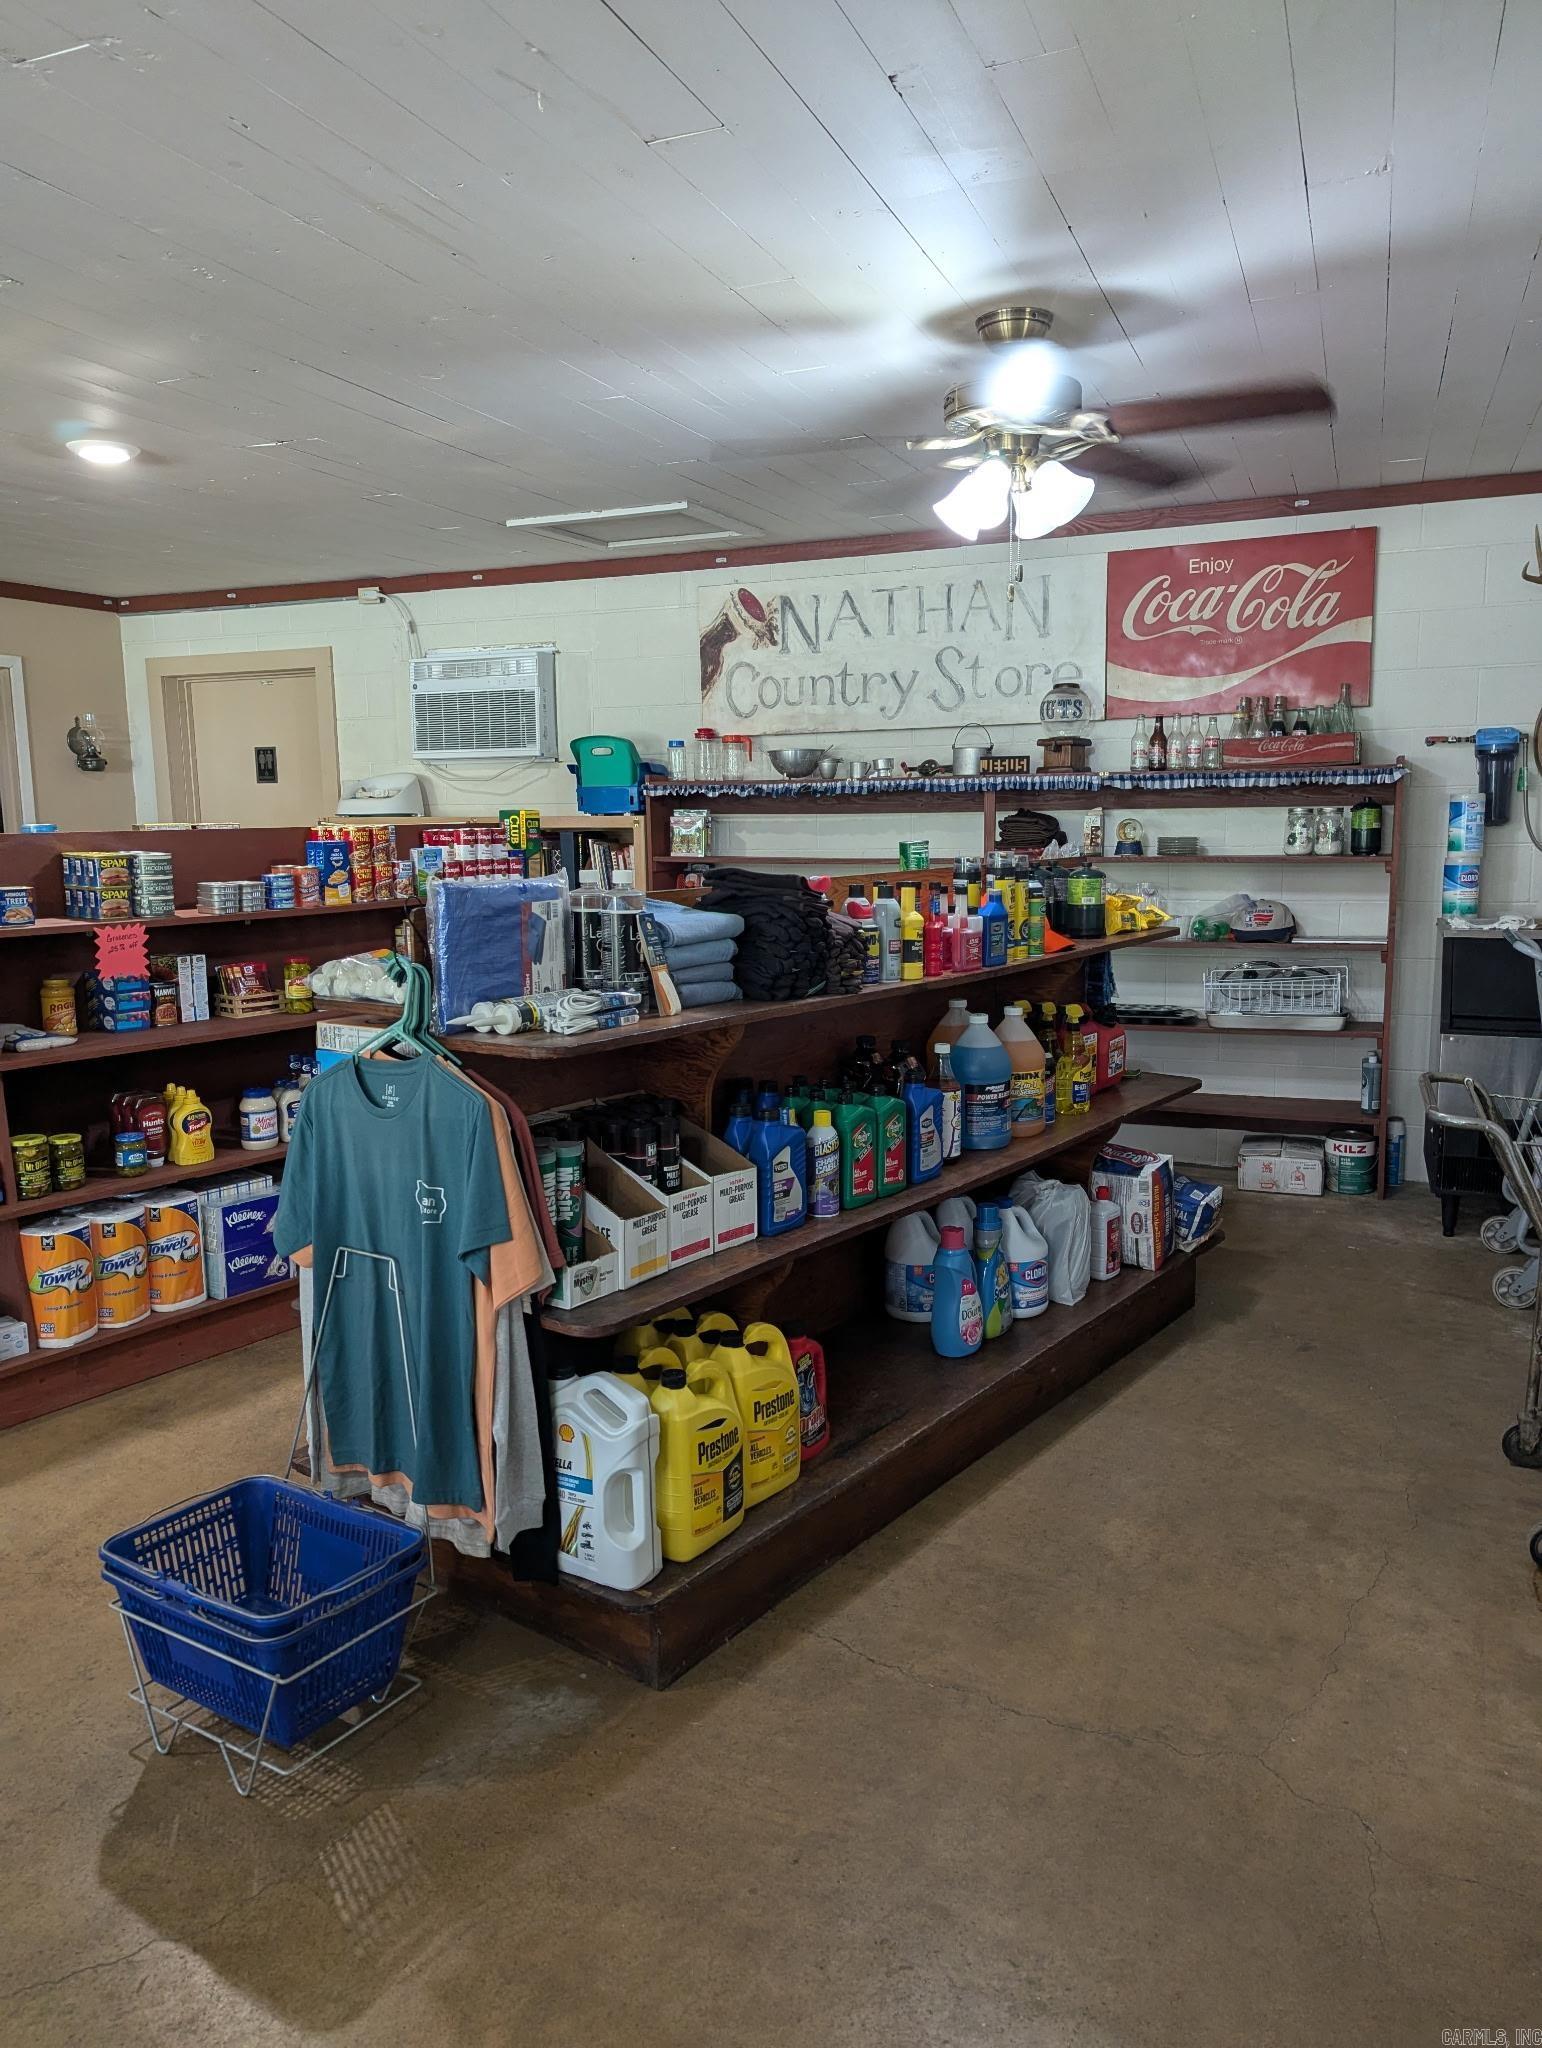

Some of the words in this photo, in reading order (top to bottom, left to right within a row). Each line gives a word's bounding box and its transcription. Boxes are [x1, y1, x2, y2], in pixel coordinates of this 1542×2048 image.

[1188, 557, 1235, 576] Enjoy
[1122, 555, 1355, 641] Coca-Cola
[779, 574, 1052, 655] NATHAN
[725, 659, 919, 721] Country
[926, 645, 1085, 713] Store
[1258, 736, 1306, 754] Coca-Cola
[509, 815, 520, 844] CLUB
[101, 857, 128, 868] SPAM
[5, 897, 28, 906] TREET
[101, 890, 128, 900] SPAM
[976, 1093, 998, 1101] POWER
[1333, 1143, 1367, 1155] KILZ
[719, 1181, 754, 1198] MULTI-PURPOSE
[728, 1192, 746, 1205] GREASE
[672, 1194, 708, 1214] MULTI-PURPOSE
[681, 1206, 699, 1220] GREASE
[225, 1210, 264, 1228] Kleenex
[632, 1210, 667, 1230] MULTI-PURPOSE
[641, 1223, 658, 1237] GREASE
[99, 1249, 141, 1275] Towels
[227, 1254, 265, 1273] Kleenex
[38, 1264, 84, 1289] Towels
[753, 1388, 795, 1424] Prestone
[697, 1426, 740, 1466] Prestone
[749, 1445, 772, 1461] VEHICLES
[555, 1457, 573, 1471] ELLA
[693, 1488, 718, 1506] VEHICLES
